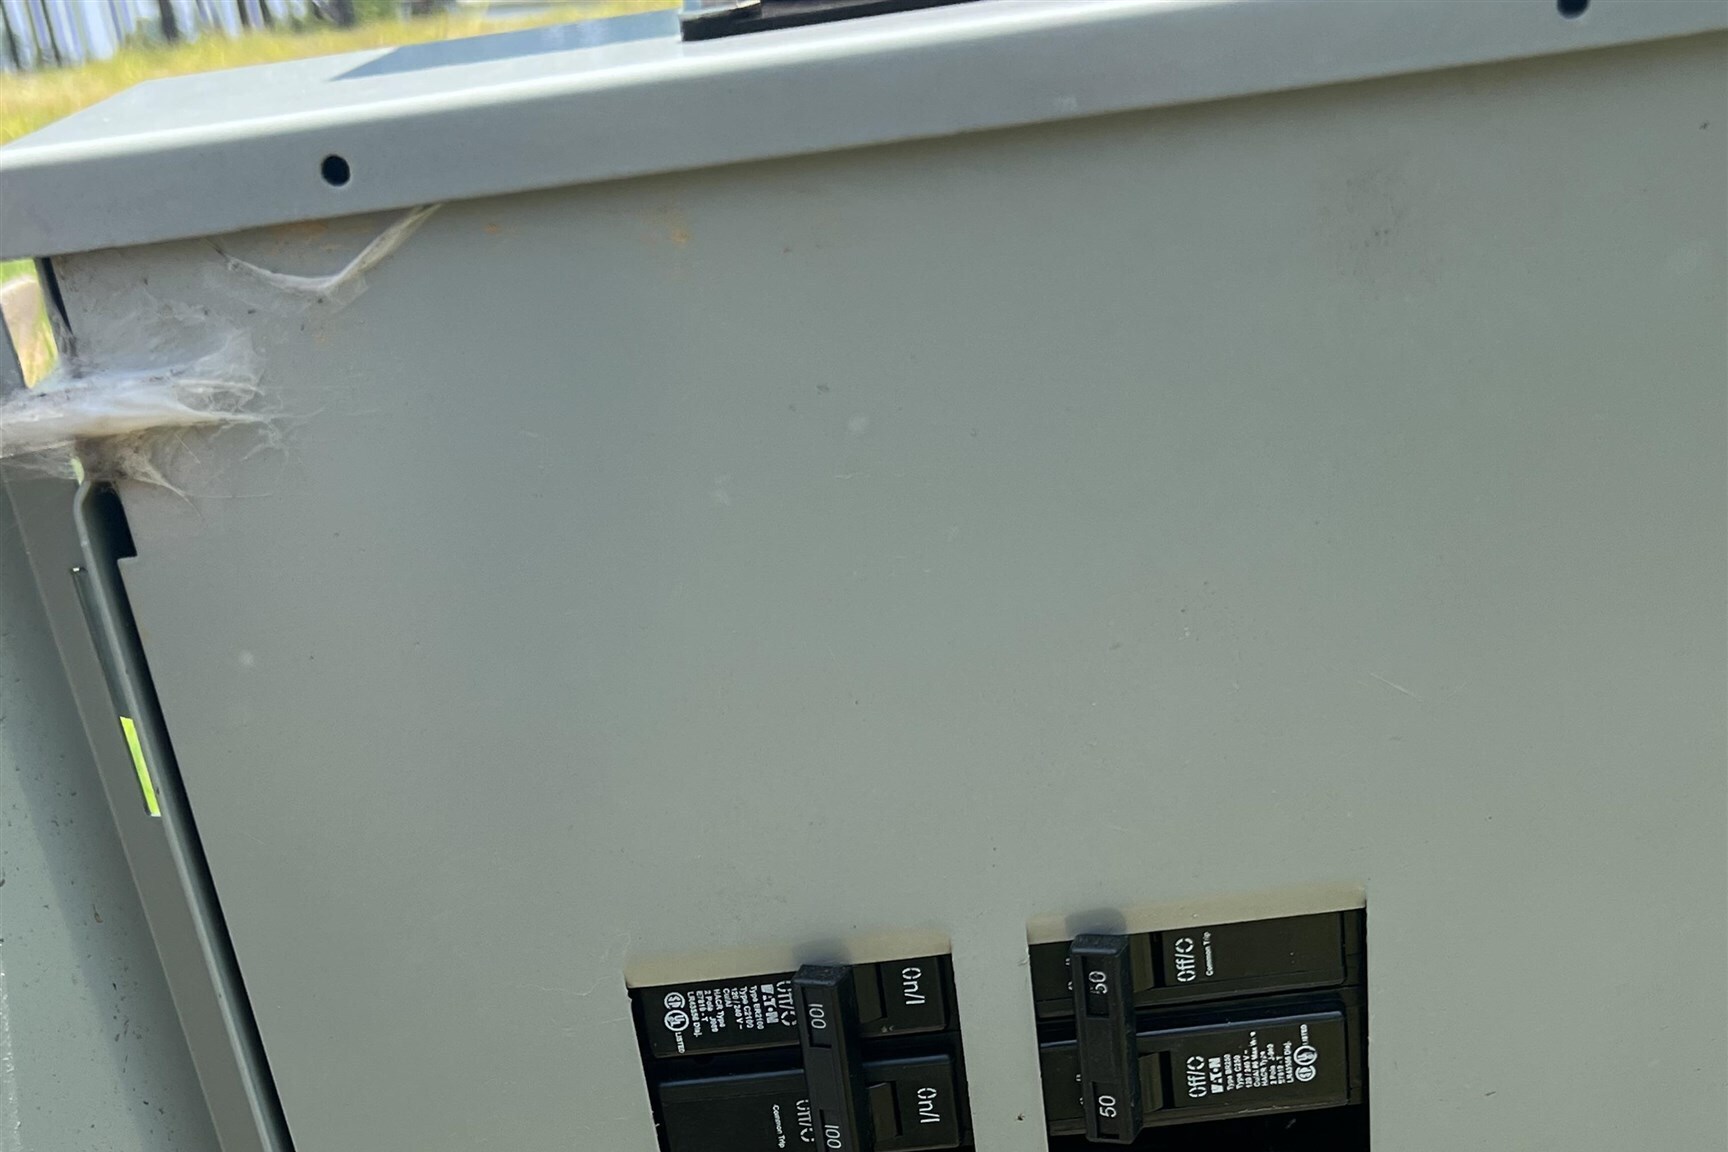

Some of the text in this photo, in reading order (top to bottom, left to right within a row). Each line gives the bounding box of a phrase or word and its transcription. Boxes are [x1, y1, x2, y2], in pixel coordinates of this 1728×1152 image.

[1088, 970, 1108, 994] 50
[808, 1003, 827, 1029] 100
[1098, 1095, 1117, 1118] 50
[772, 1104, 786, 1149] Common Trip
[824, 1125, 842, 1149] 100
